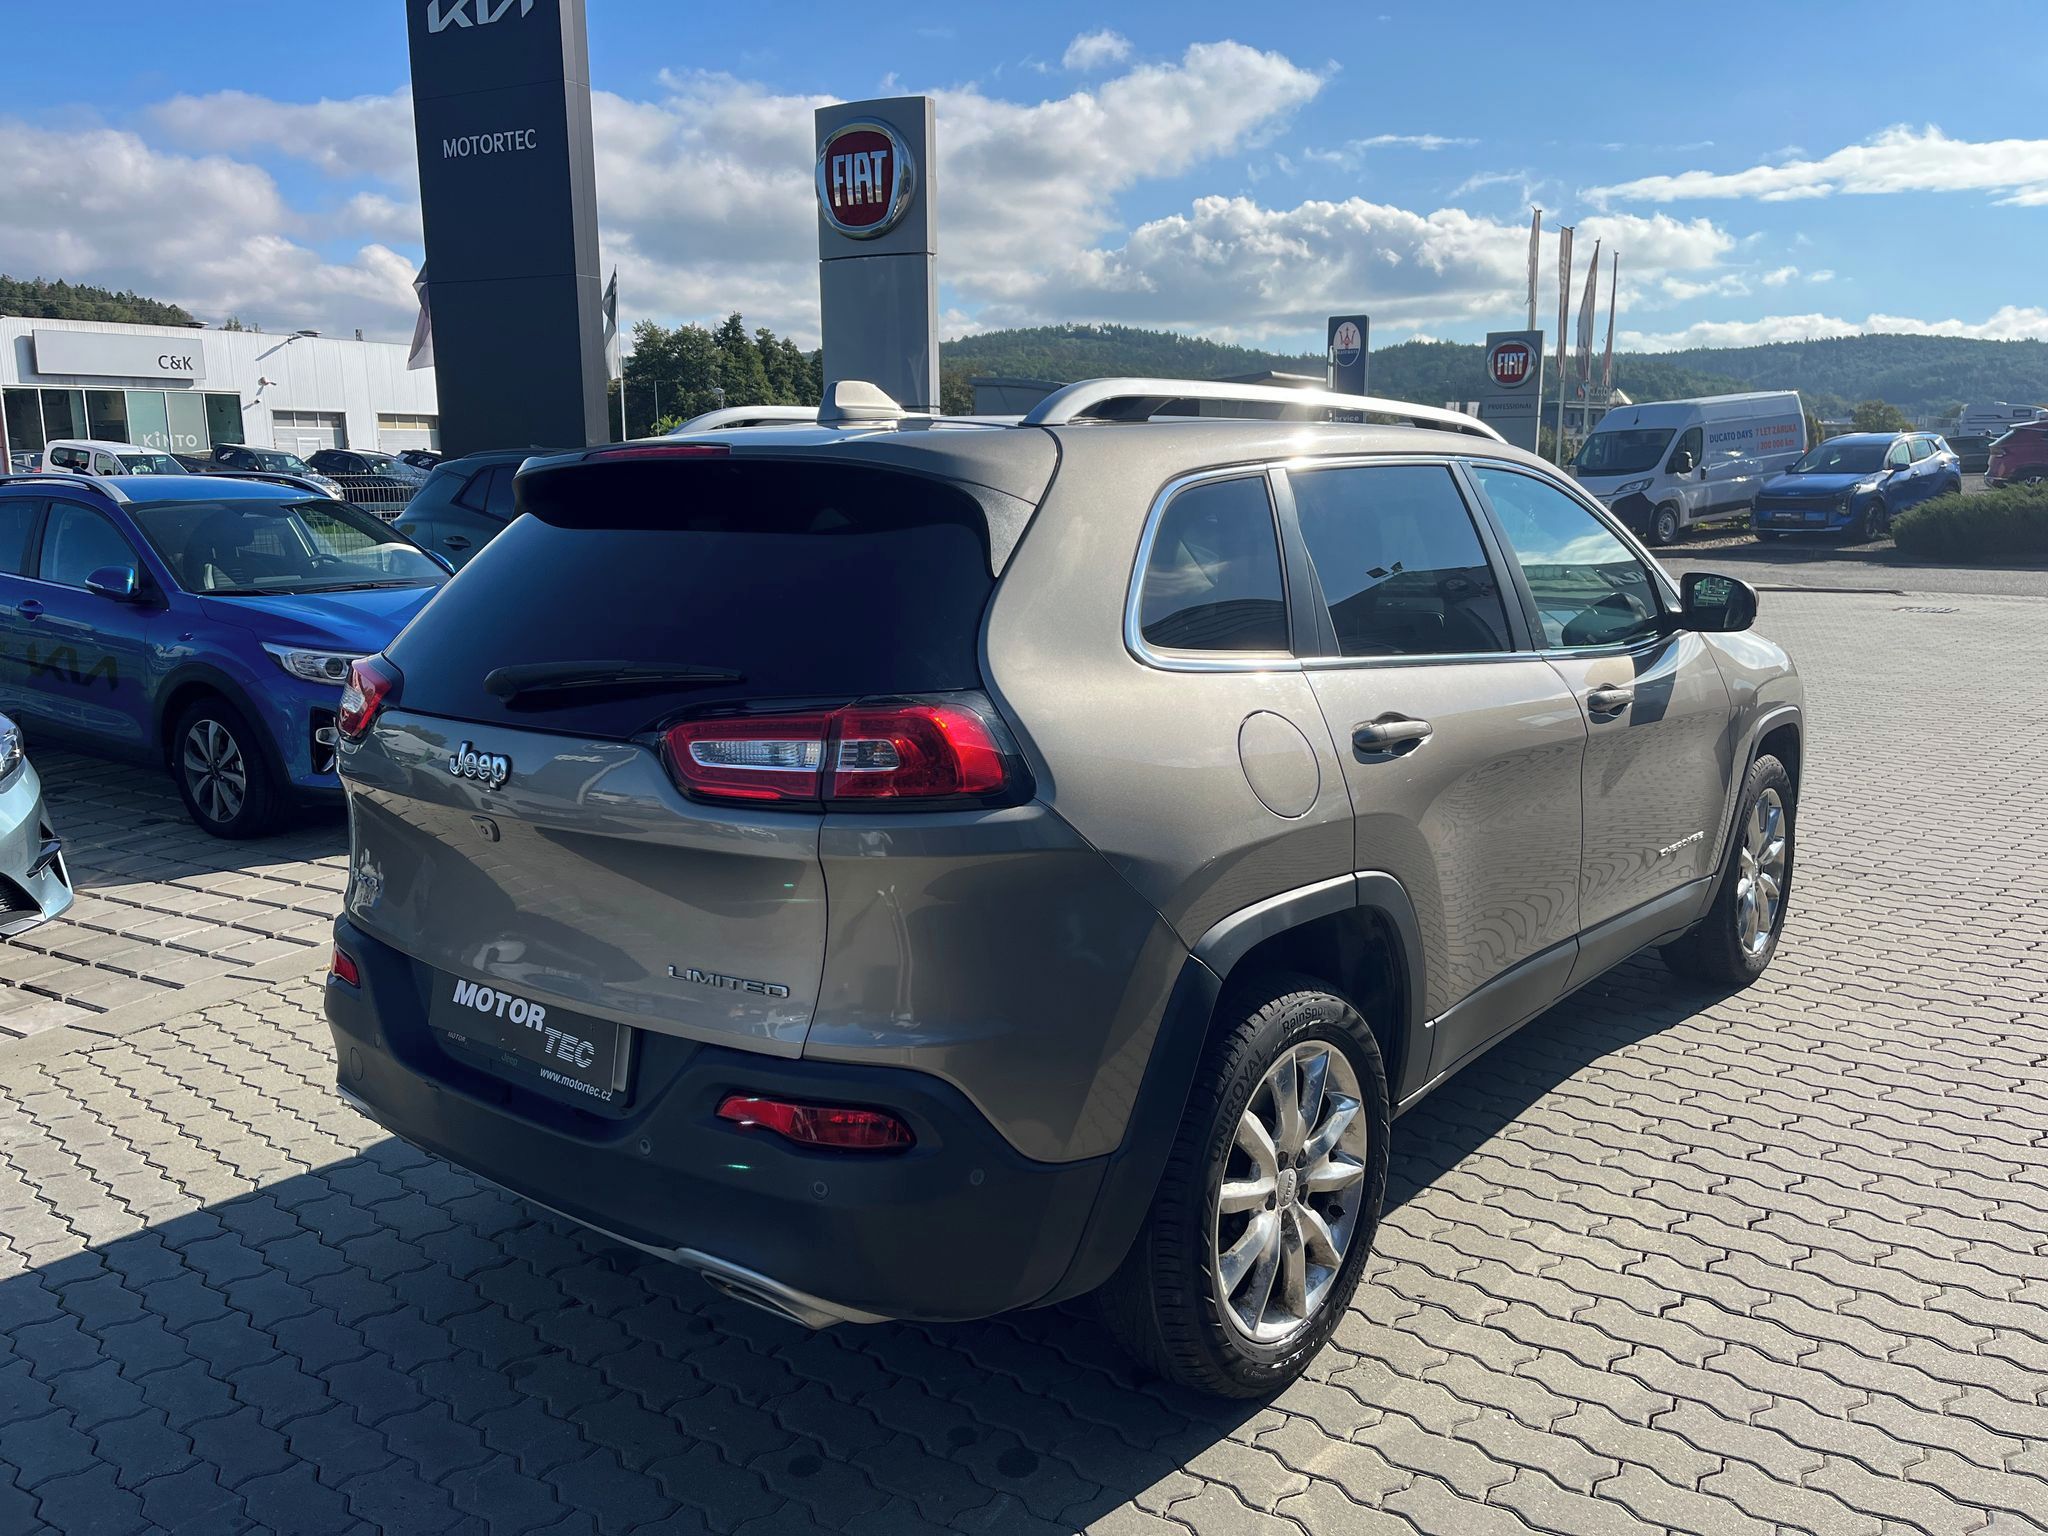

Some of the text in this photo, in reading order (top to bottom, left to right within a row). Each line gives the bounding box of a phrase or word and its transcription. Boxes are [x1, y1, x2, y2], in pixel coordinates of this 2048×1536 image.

[443, 128, 537, 159] MOTORTEC
[832, 150, 888, 207] FIAT
[157, 355, 193, 371] C&K
[1497, 352, 1526, 375] FIAT
[1487, 402, 1532, 410] PROFESSIONAL
[1709, 429, 1753, 444] DUCATO DAYS
[1760, 426, 1772, 437] LET
[1772, 423, 1797, 435] ZÁRUKA
[449, 740, 513, 791] Jeep
[668, 965, 790, 999] LIMITED
[452, 979, 595, 1069] MOTOR TEC
[540, 1067, 613, 1102] www.motortec.cz
[1211, 1050, 1268, 1163] UNIROYAL
